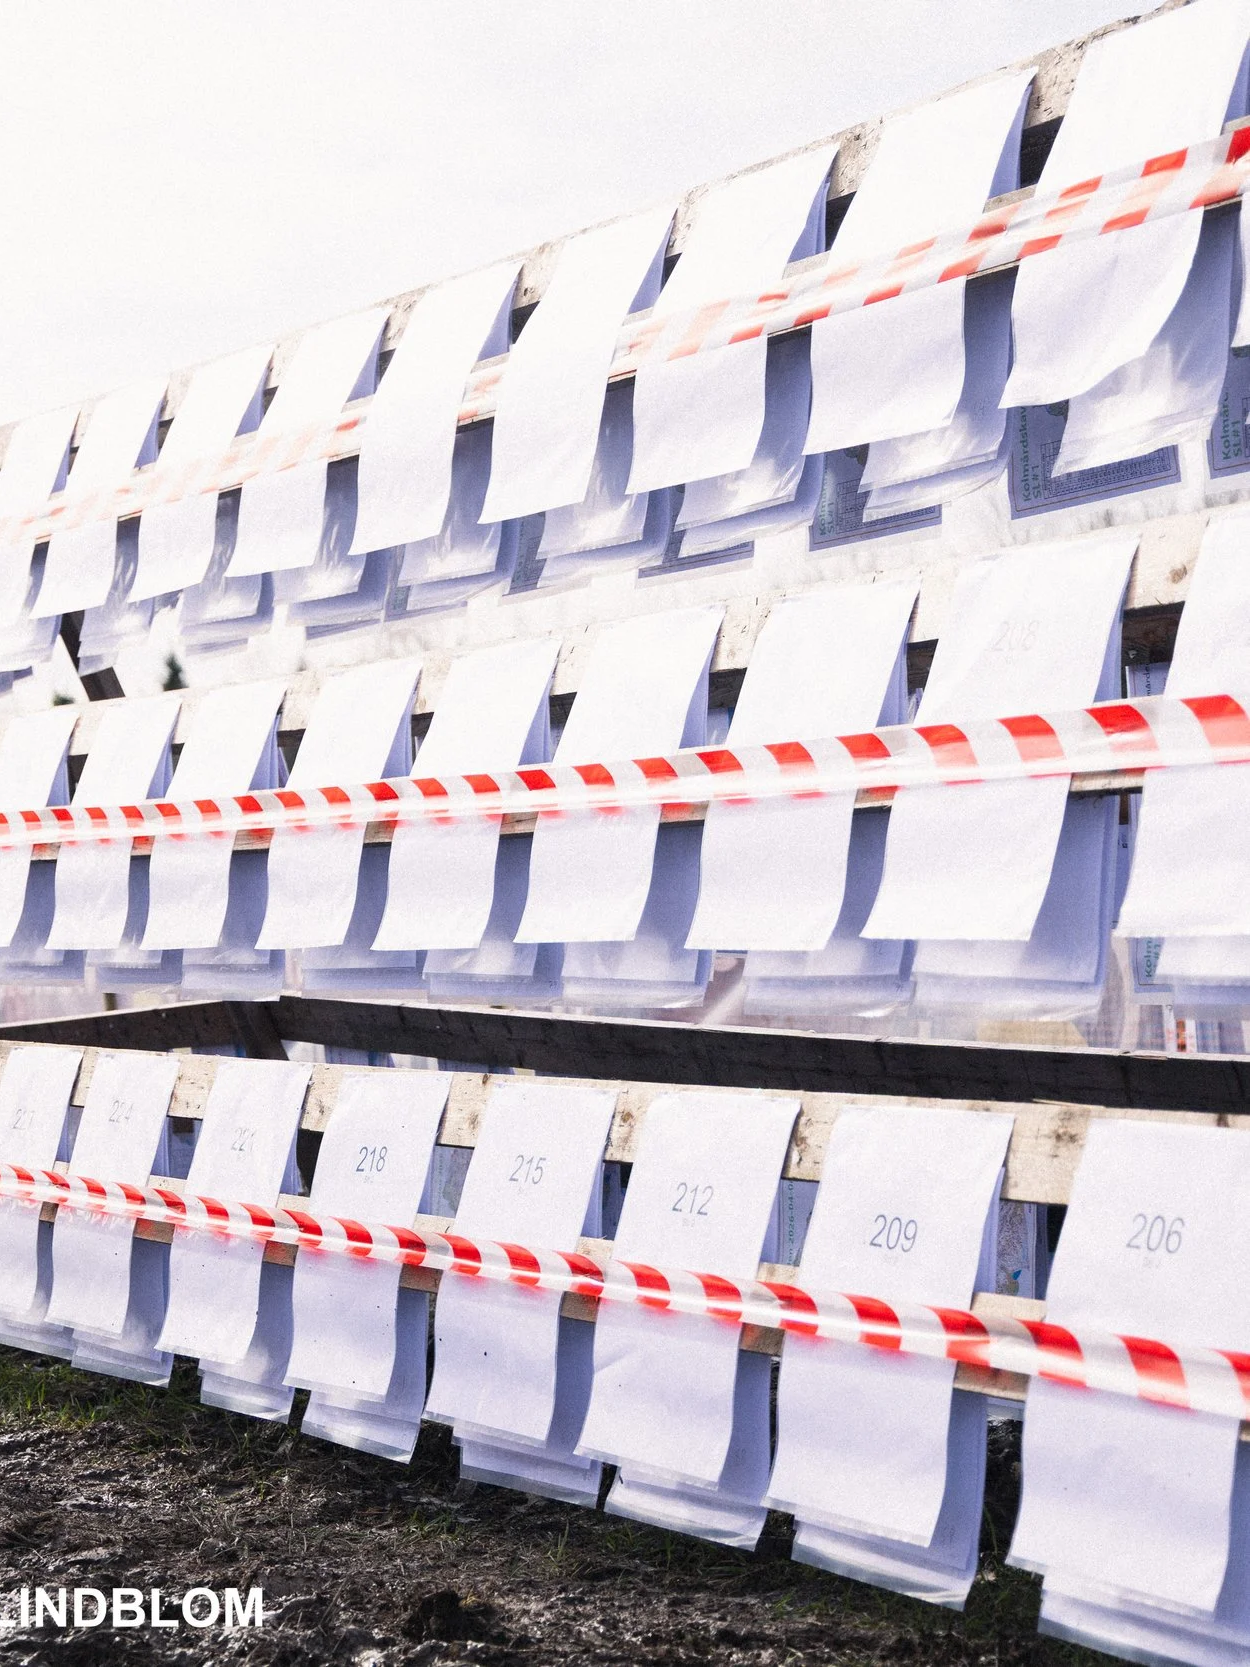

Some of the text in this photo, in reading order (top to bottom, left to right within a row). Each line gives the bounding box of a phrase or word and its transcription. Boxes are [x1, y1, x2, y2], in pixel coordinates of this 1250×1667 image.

[355, 1146, 388, 1172] 218
[508, 1154, 546, 1184] 215
[671, 1181, 714, 1216] 212
[787, 1181, 795, 1244] 2026-04-0
[869, 1214, 918, 1252] 209
[1125, 1213, 1186, 1254] 206
